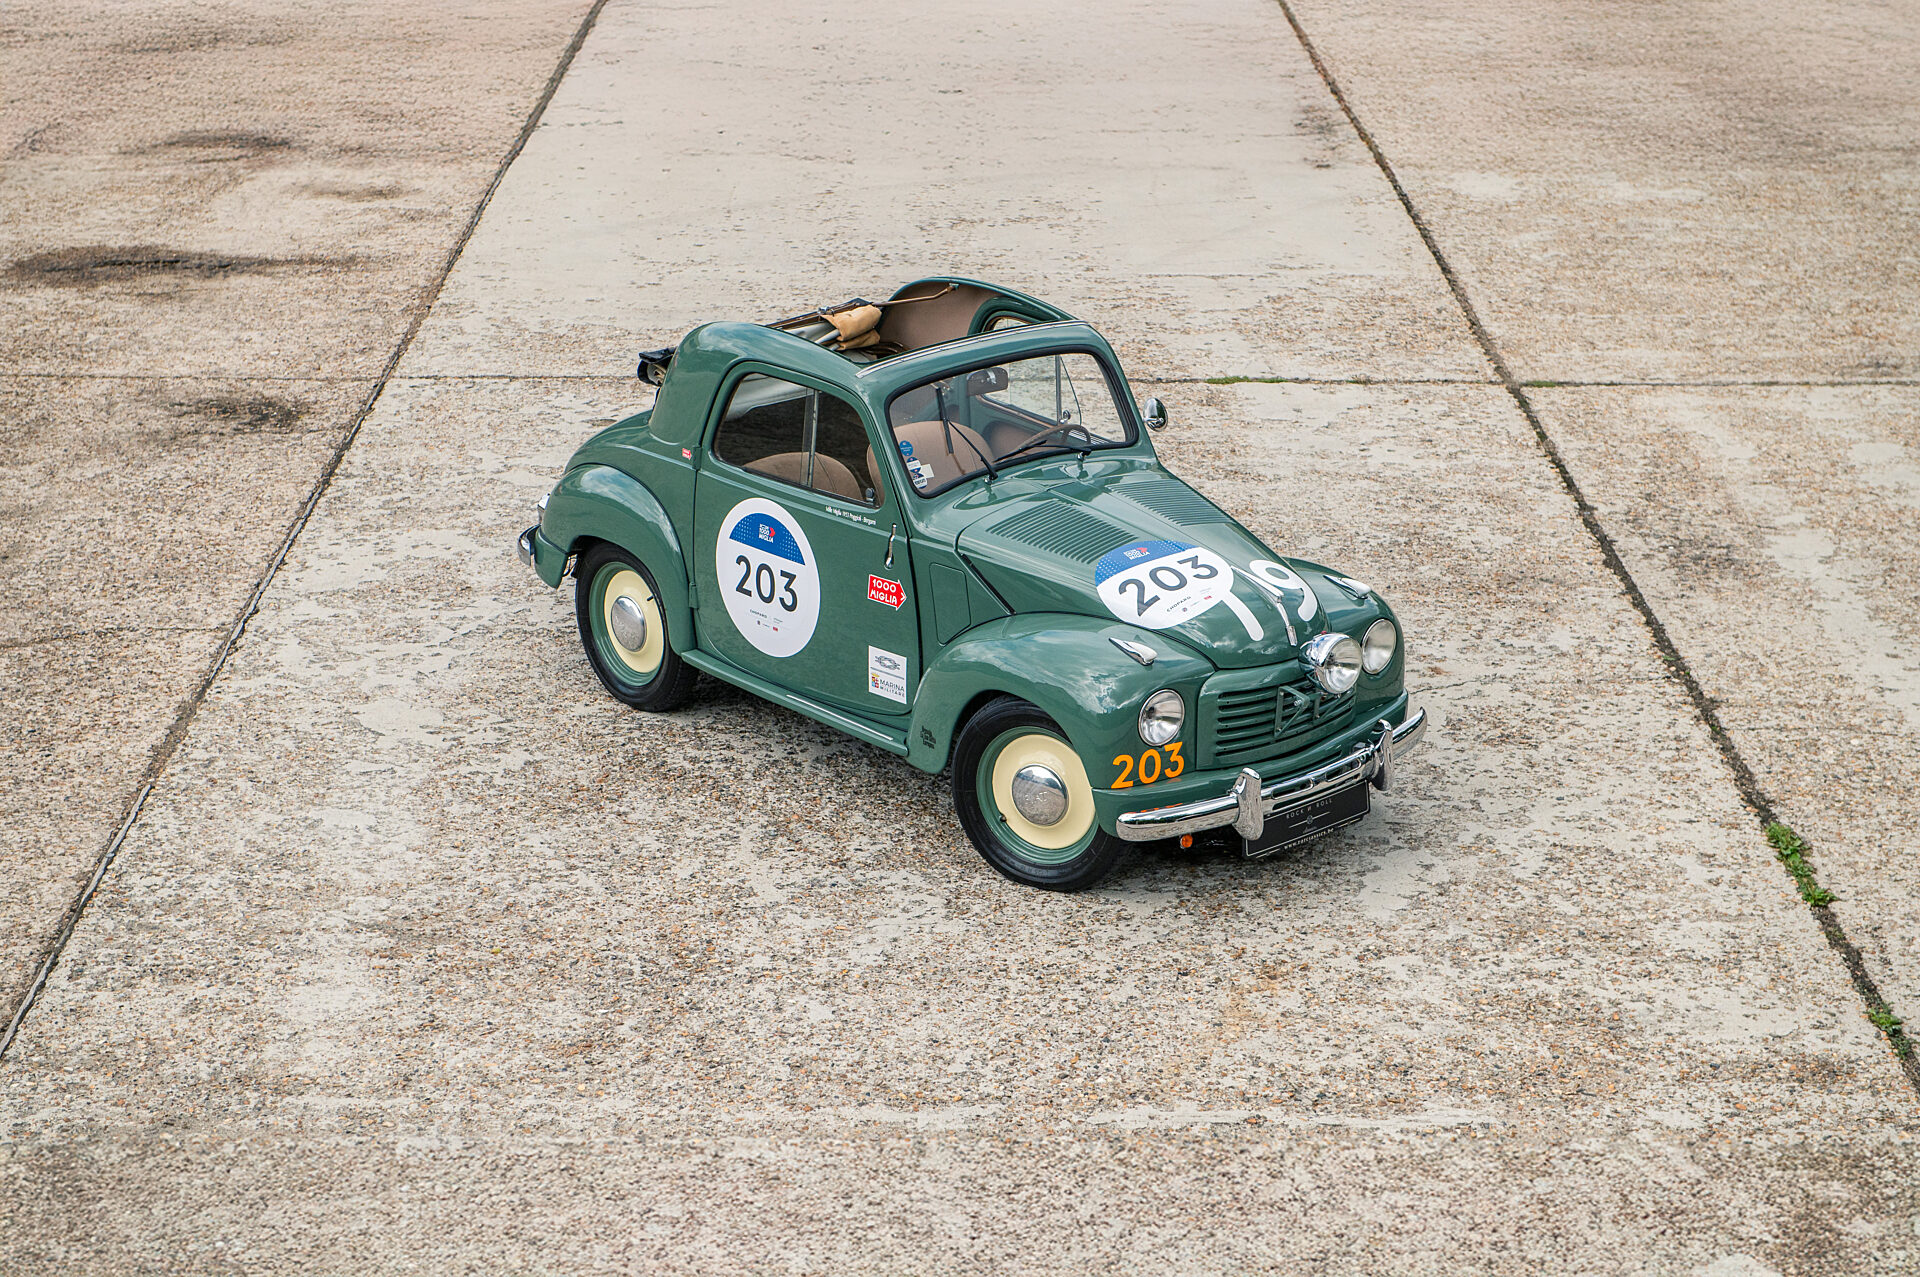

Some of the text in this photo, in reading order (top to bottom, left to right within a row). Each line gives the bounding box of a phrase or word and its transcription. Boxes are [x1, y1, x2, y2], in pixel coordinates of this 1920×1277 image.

[735, 554, 798, 612] 203
[872, 578, 897, 593] 1000
[1118, 555, 1219, 617] 203
[869, 588, 898, 605] MIGLIA
[879, 678, 905, 692] MARINA
[1110, 741, 1185, 789] 203
[1286, 809, 1304, 819] ROCK
[1316, 799, 1332, 807] ROLL
